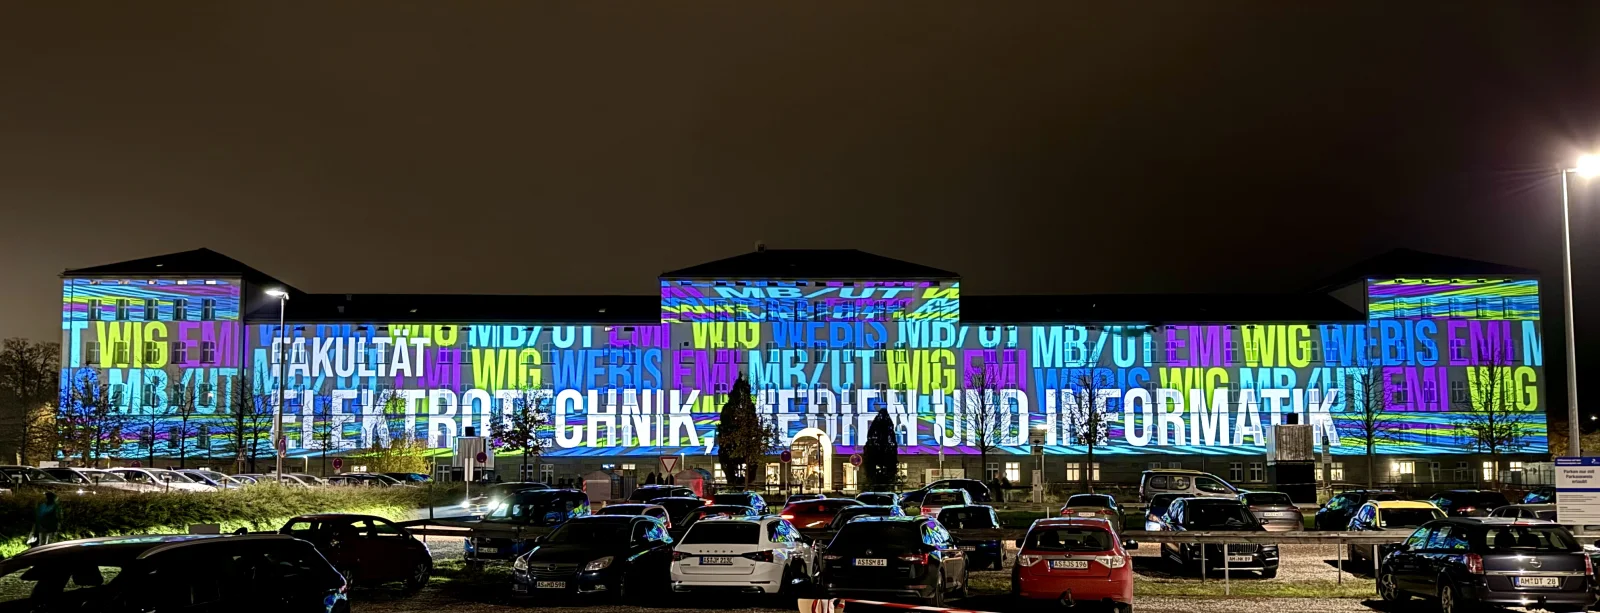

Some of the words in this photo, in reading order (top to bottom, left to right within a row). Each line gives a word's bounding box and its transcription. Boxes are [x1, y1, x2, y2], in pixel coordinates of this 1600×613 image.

[712, 287, 914, 299] MB/UT
[96, 321, 168, 368] WIG
[178, 321, 249, 367] EMI
[272, 329, 430, 377] FAKULTÄT
[692, 321, 760, 348] WIG
[772, 321, 888, 348] WEBIS
[897, 321, 1018, 348] MB/UT
[1032, 325, 1153, 368] MB/UT
[1166, 325, 1233, 367] EMI
[1241, 325, 1311, 367] WIG
[1320, 320, 1438, 367] WEBIS
[1449, 320, 1514, 366] EMI
[107, 367, 240, 415] MB/UT
[395, 348, 461, 393] MI
[472, 348, 542, 391] WIG
[552, 348, 663, 394] WEBIS
[673, 349, 743, 394] EMI
[749, 349, 875, 394] MB/UT
[886, 350, 956, 395] WIG
[964, 349, 1027, 393] EMI
[1159, 367, 1230, 412] WIG
[1239, 367, 1372, 412] MB/UT
[1382, 366, 1449, 411] EMI
[1466, 366, 1538, 411] WIG
[933, 388, 1029, 446] UND
[1046, 387, 1342, 446] INFORMATIK
